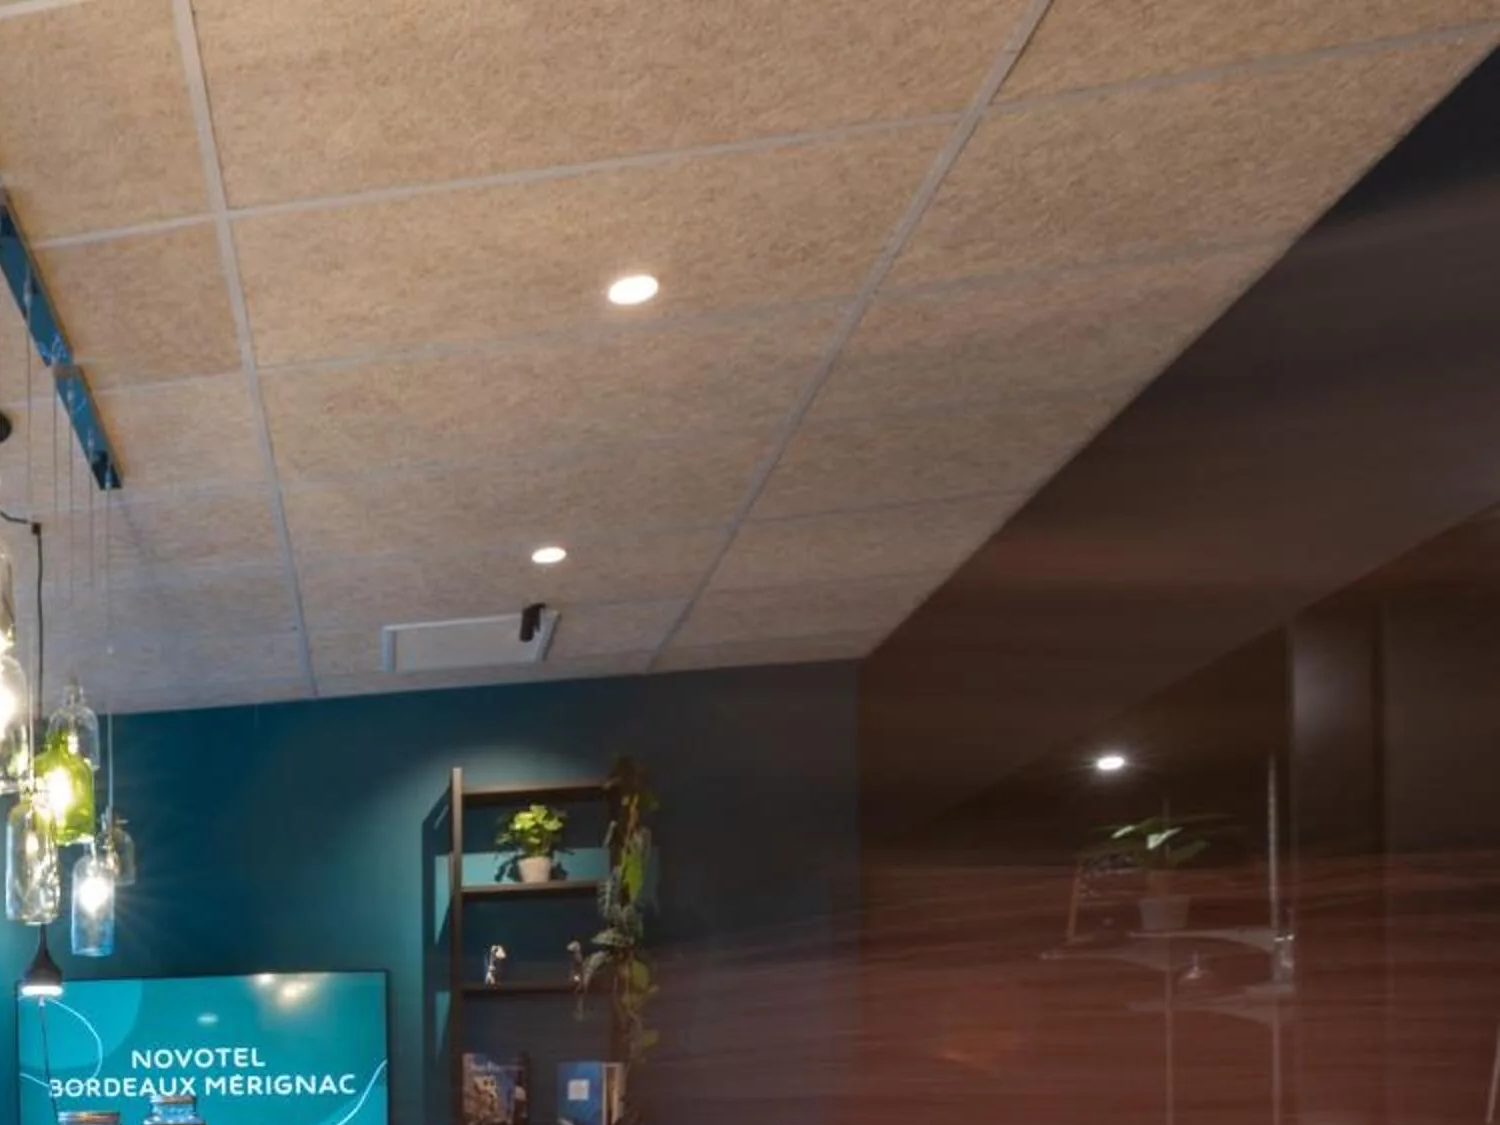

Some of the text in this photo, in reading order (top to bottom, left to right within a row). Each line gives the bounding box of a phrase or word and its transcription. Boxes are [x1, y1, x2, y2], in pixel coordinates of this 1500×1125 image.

[131, 1047, 266, 1070] NOVOTEL
[50, 1073, 357, 1098] BORDEAUX MÉRIGNAC
